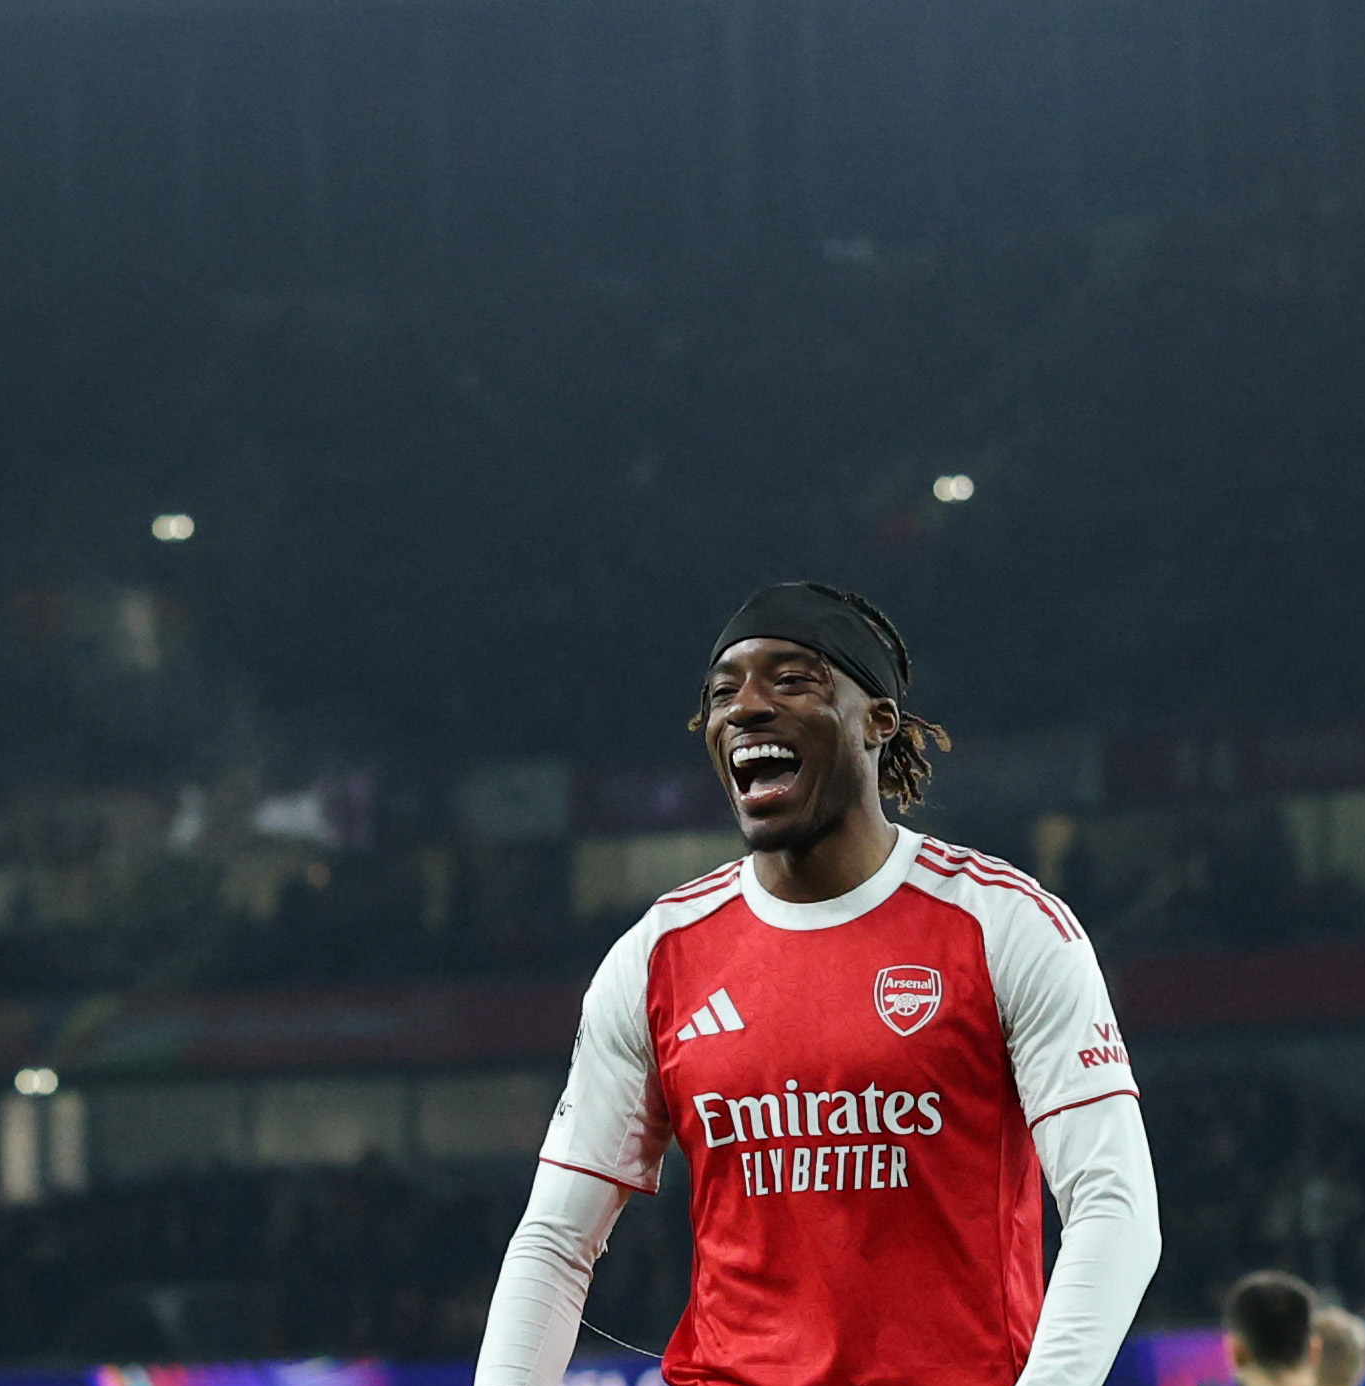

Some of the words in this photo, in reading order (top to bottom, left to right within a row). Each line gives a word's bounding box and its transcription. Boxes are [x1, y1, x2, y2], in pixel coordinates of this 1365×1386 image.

[884, 977, 932, 990] Arsenal
[692, 1079, 943, 1148] Emirates
[791, 1144, 909, 1193] BETTER
